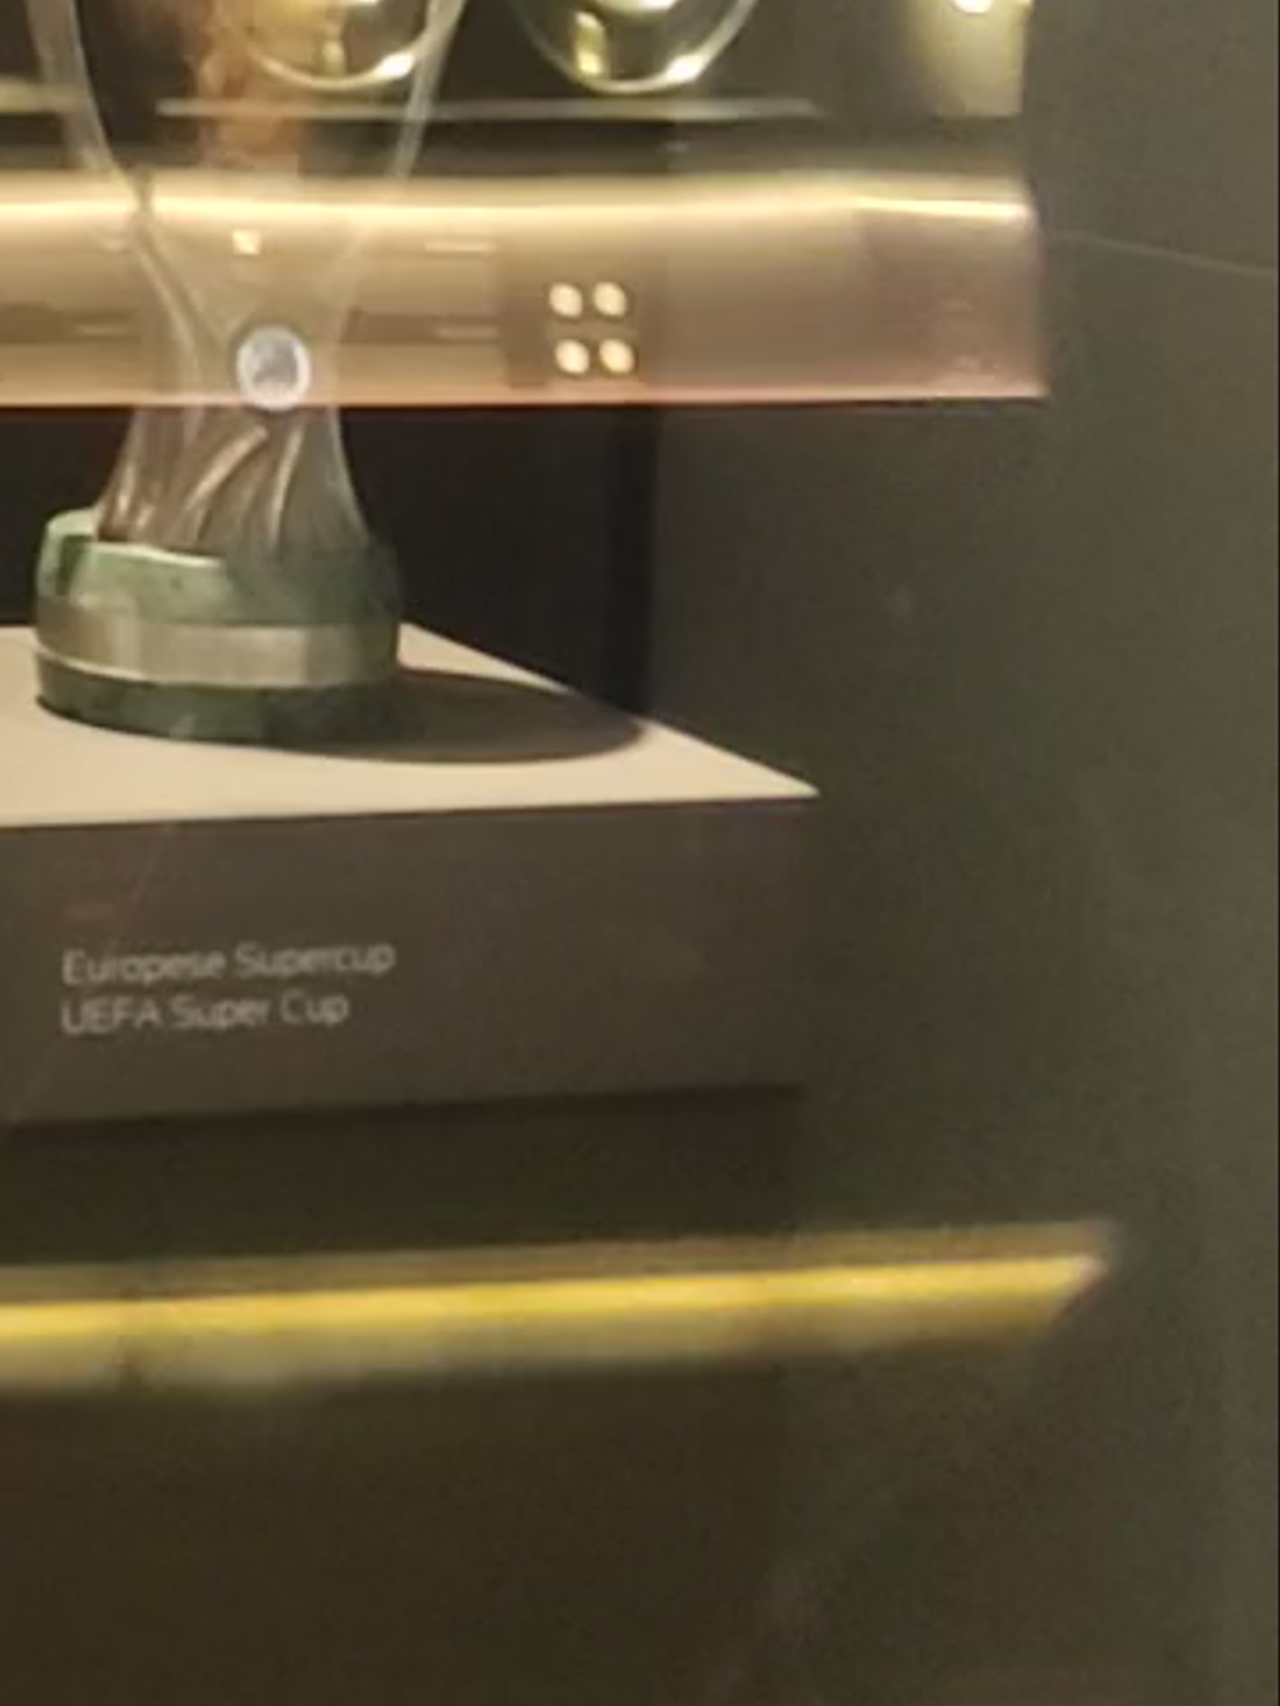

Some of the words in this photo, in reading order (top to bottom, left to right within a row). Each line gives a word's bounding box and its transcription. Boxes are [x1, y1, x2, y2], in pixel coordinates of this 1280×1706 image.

[62, 946, 226, 986] Europese
[234, 941, 397, 979] Supercup
[61, 995, 162, 1035] UEFA
[171, 993, 271, 1030] Super
[281, 990, 350, 1026] Cup
